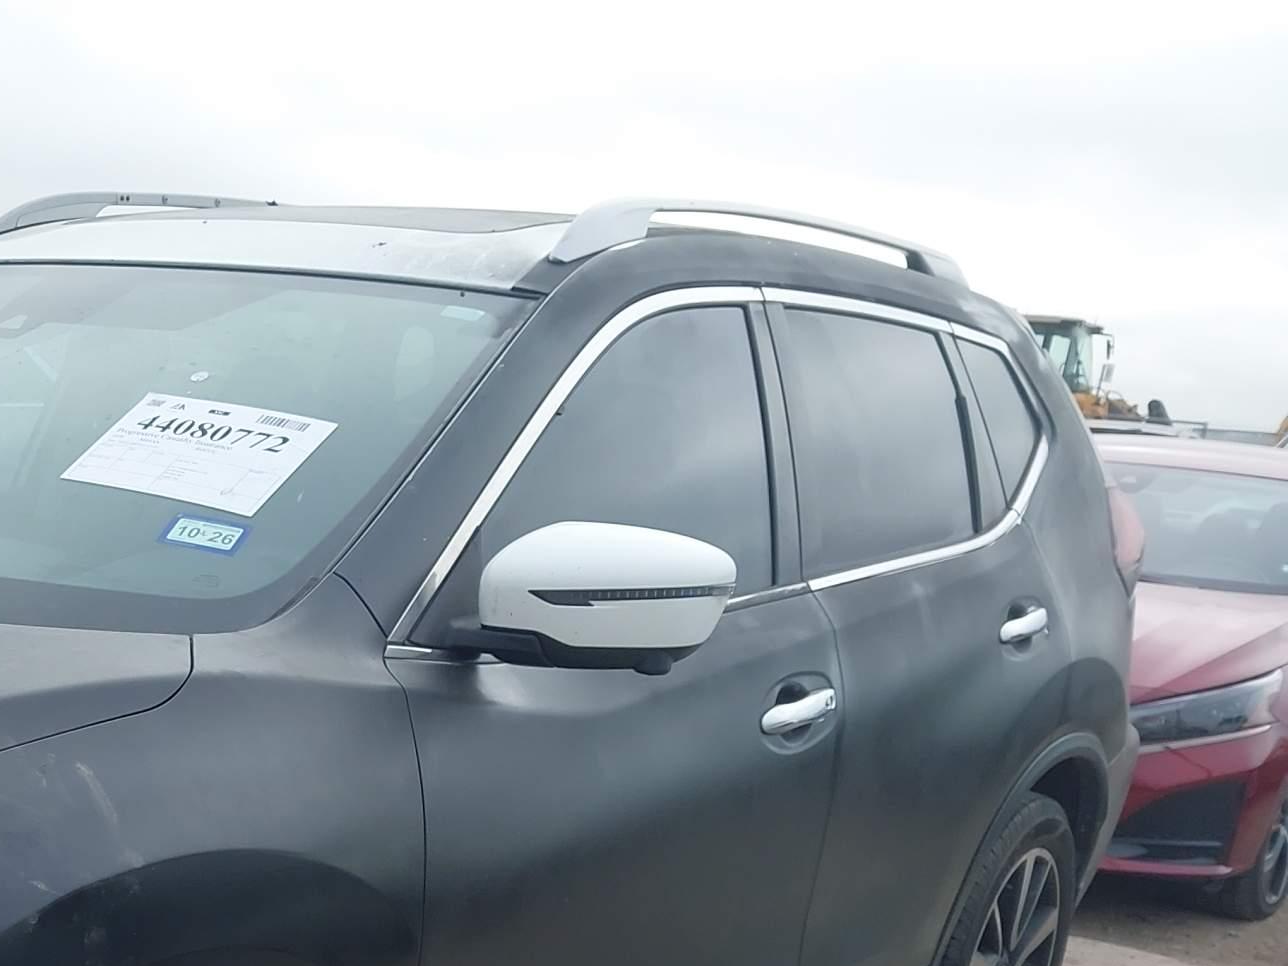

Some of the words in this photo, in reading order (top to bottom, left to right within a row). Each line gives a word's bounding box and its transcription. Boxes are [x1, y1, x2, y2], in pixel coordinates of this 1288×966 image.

[136, 415, 291, 453] 44080772
[178, 526, 201, 538] 10
[207, 531, 236, 545] 26
